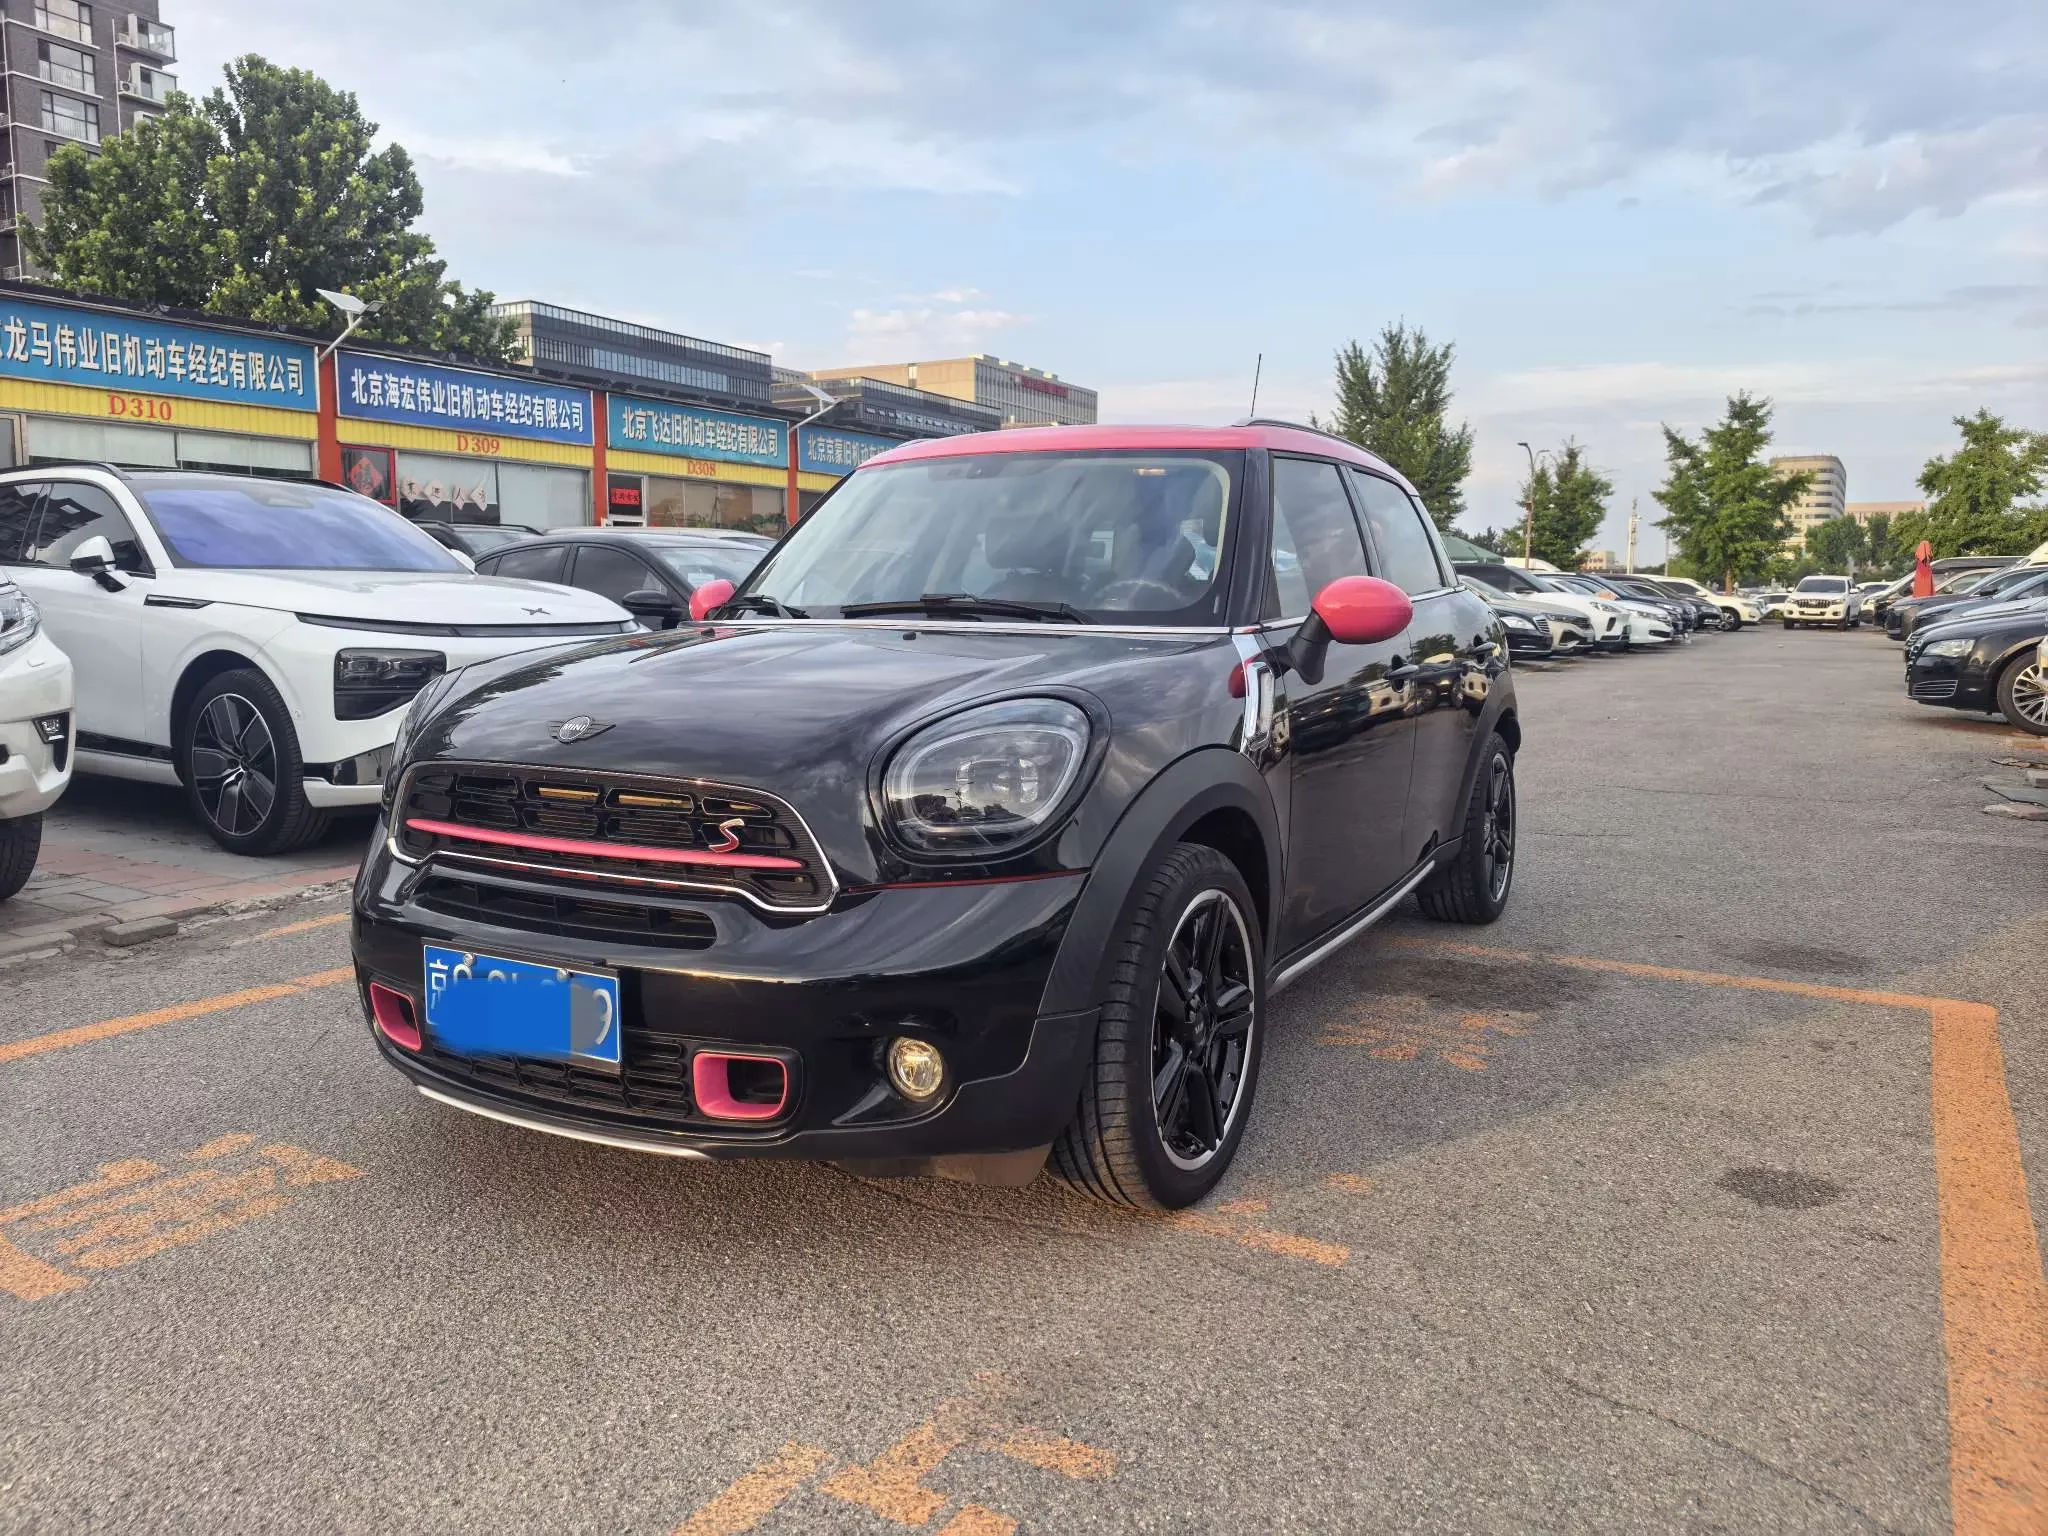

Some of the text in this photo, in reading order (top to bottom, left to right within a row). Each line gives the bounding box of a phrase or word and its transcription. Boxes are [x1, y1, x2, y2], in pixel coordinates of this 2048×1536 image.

[0, 315, 304, 396] 龙马伟业旧机动车经纪有限公司
[351, 367, 584, 433] 北京海宏伟业旧机动车经纪有限公司
[622, 405, 779, 457] 北京飞达旧机动车经纪有限公司
[687, 459, 717, 477] D308
